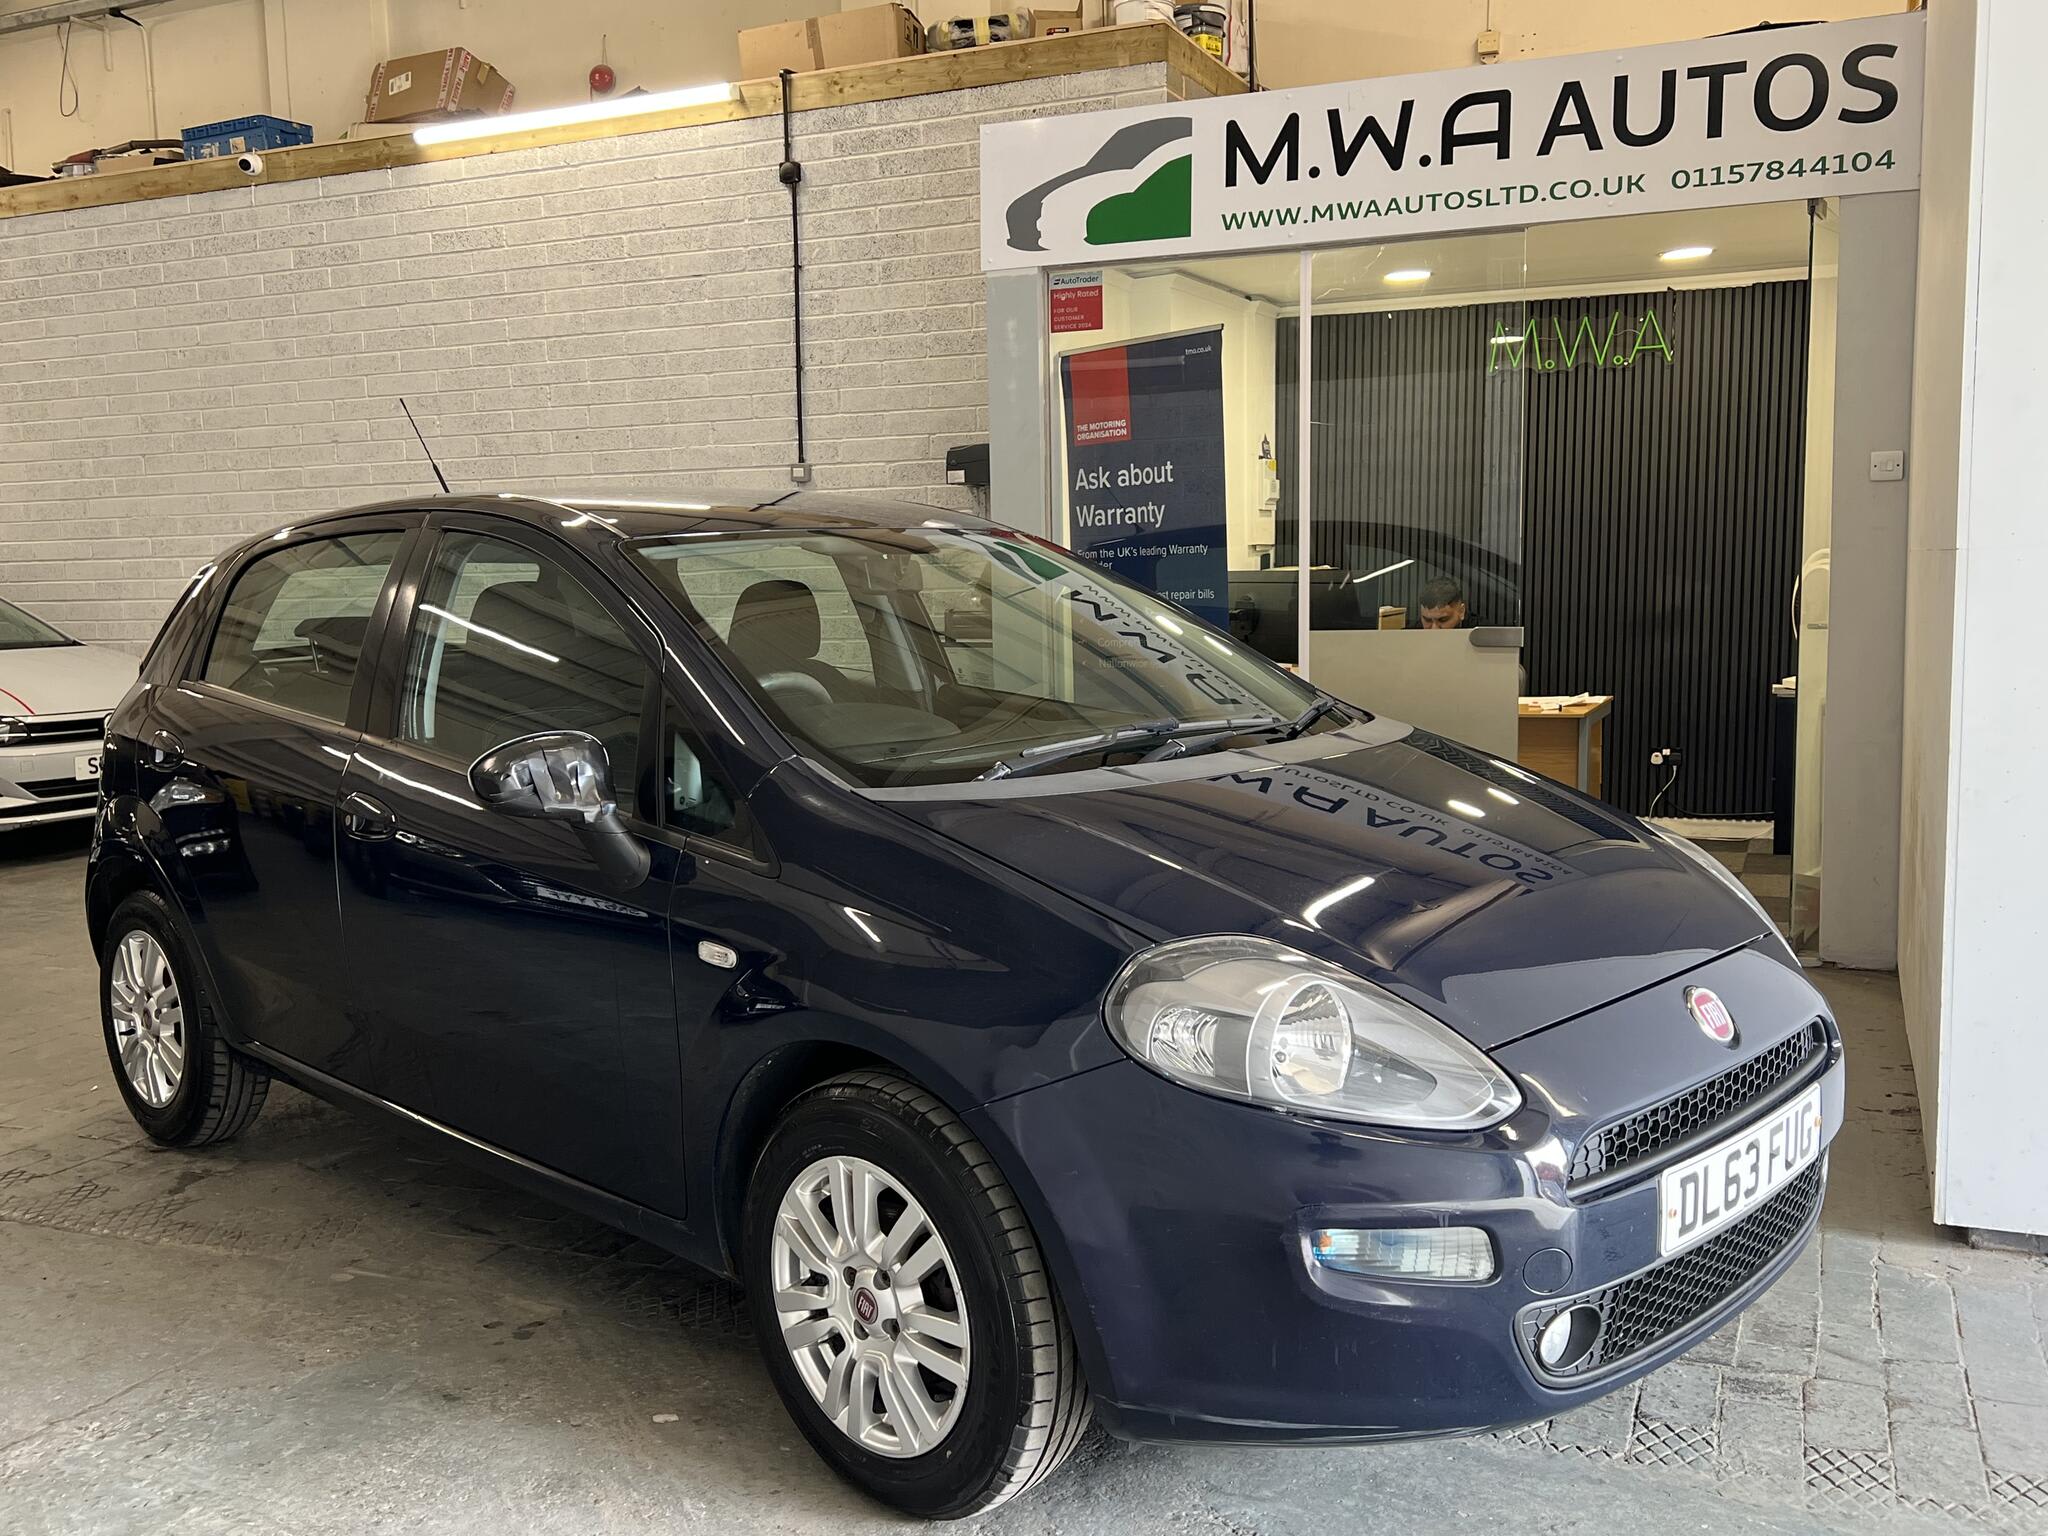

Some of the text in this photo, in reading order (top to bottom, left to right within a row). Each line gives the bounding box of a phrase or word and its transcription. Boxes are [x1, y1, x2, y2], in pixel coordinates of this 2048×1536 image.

[1225, 43, 1899, 187] M.W.A AUTOS
[1221, 149, 1896, 231] WWW.MWAAUTOSLTD.CO.UK 01157844104
[1060, 276, 1099, 285] AutoTrader
[1053, 289, 1099, 300] Highly Rated
[1488, 309, 1672, 373] M.W.A
[1077, 419, 1126, 433] THE MOTORING
[1077, 428, 1127, 441] ORGANISATION
[1075, 461, 1174, 491] Ask about
[1076, 501, 1165, 528] Warranty
[1099, 547, 1115, 558] the
[1117, 546, 1137, 557] UK's
[1139, 546, 1167, 558] leading
[1168, 543, 1209, 556] Warranty
[1170, 589, 1196, 601] repair
[1197, 588, 1215, 599] bills
[1679, 1101, 1813, 1238] DL63 FUG
[857, 1295, 874, 1319] FIAT
